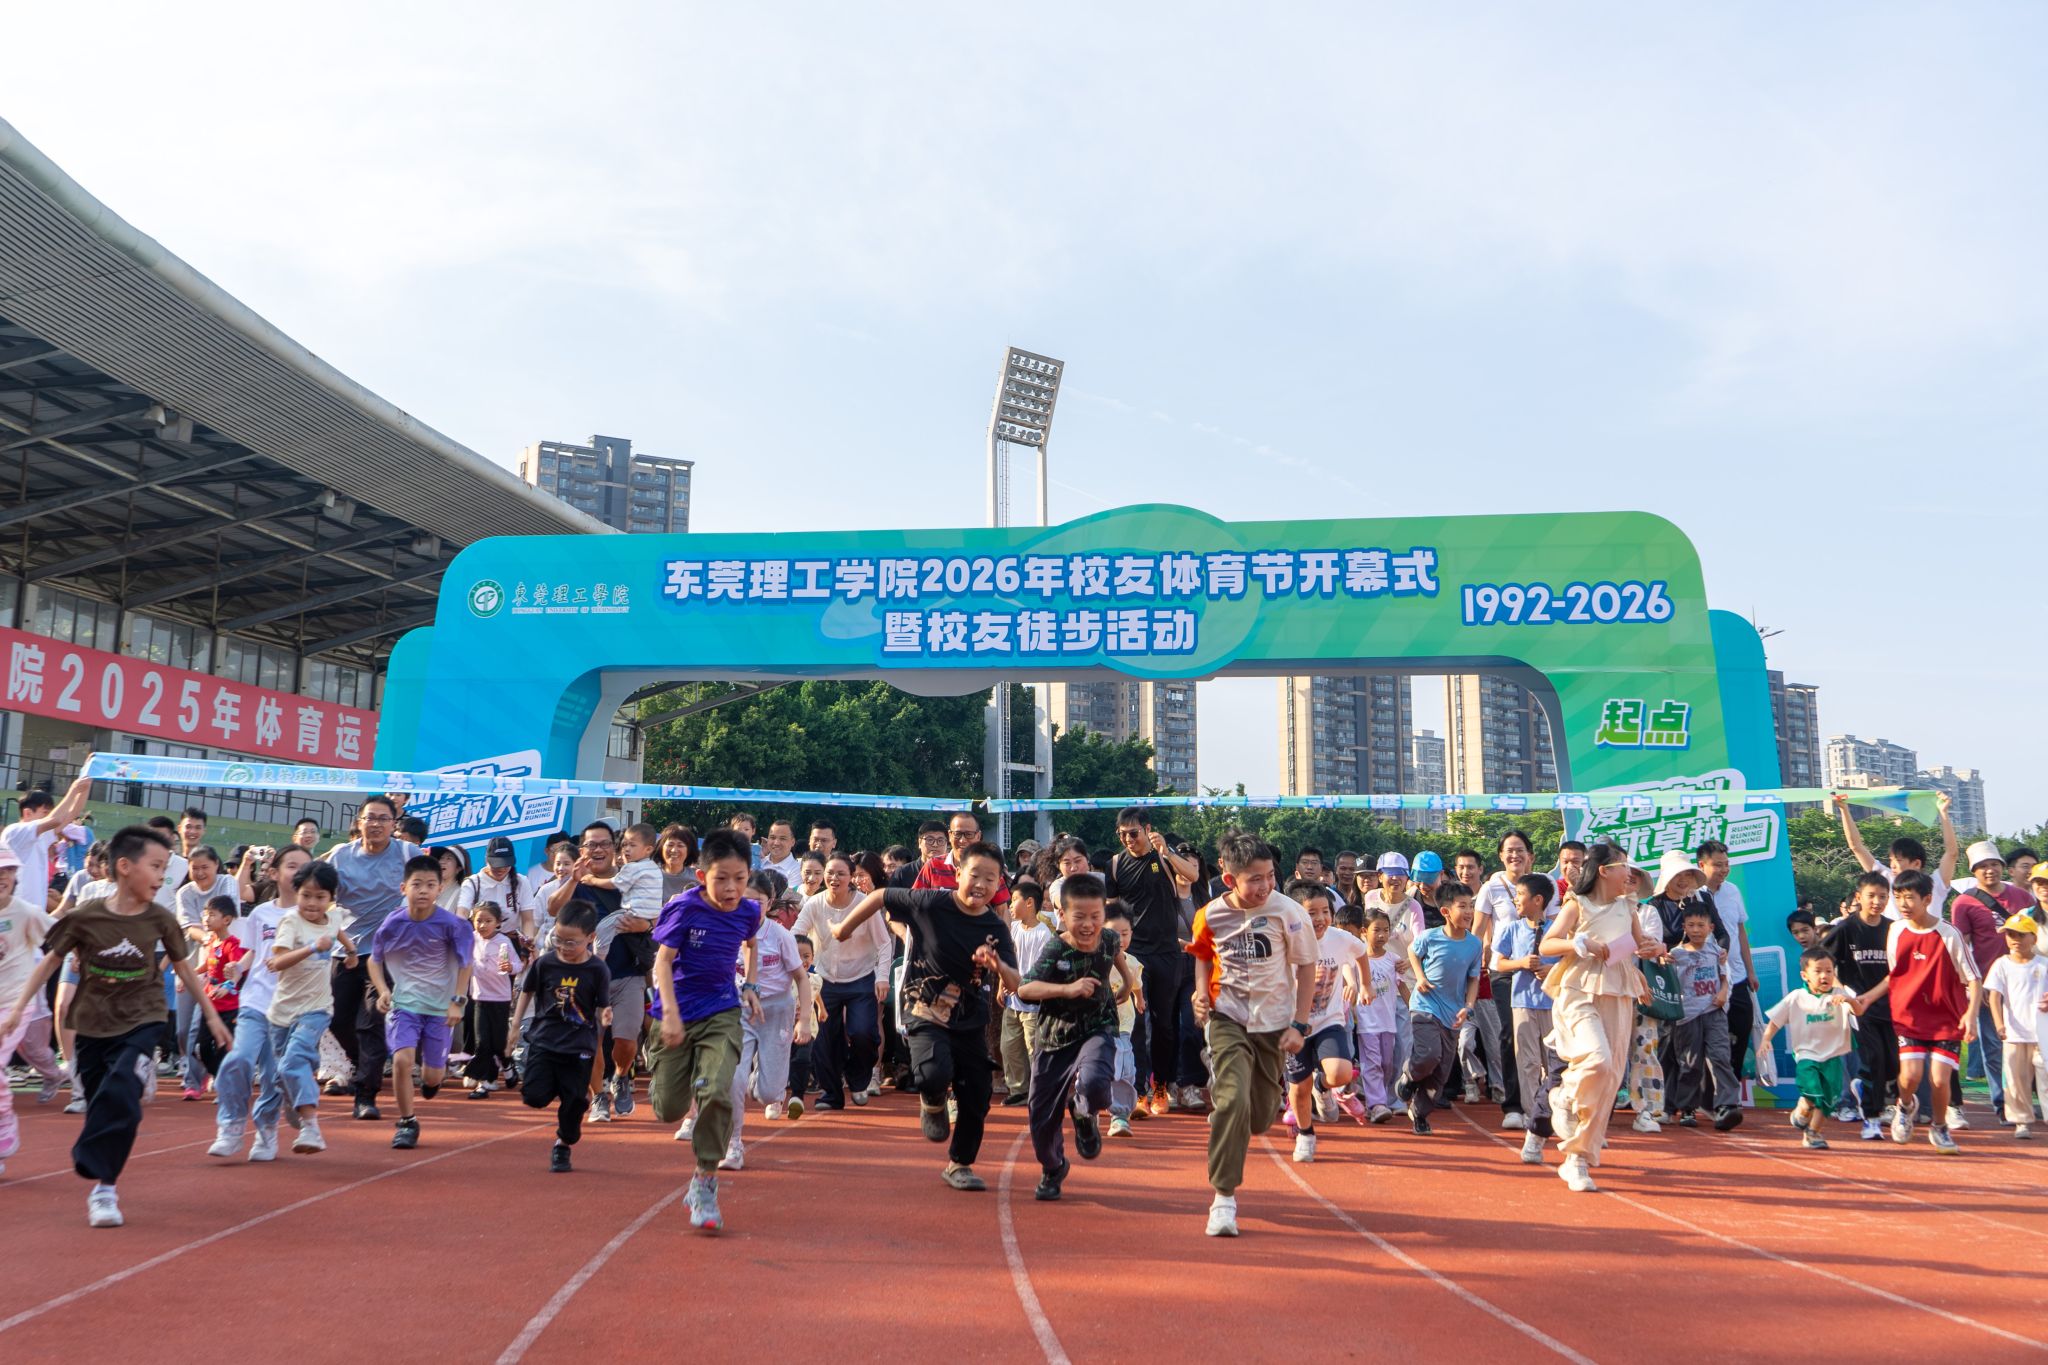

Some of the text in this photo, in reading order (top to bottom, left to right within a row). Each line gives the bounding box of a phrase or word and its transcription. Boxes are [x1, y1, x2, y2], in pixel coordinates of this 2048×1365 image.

[664, 550, 1437, 600] 东莞理工学院2026年校友体育节开幕式
[1464, 584, 1672, 623] 1992-2026
[884, 608, 1196, 654] 暨校友徒步活动
[6, 641, 380, 763] 院2025年体育运
[1595, 699, 1690, 748] 起点
[1728, 836, 1762, 846] RUNING
[1730, 829, 1763, 840] RUNING
[1731, 823, 1764, 833] RUNING
